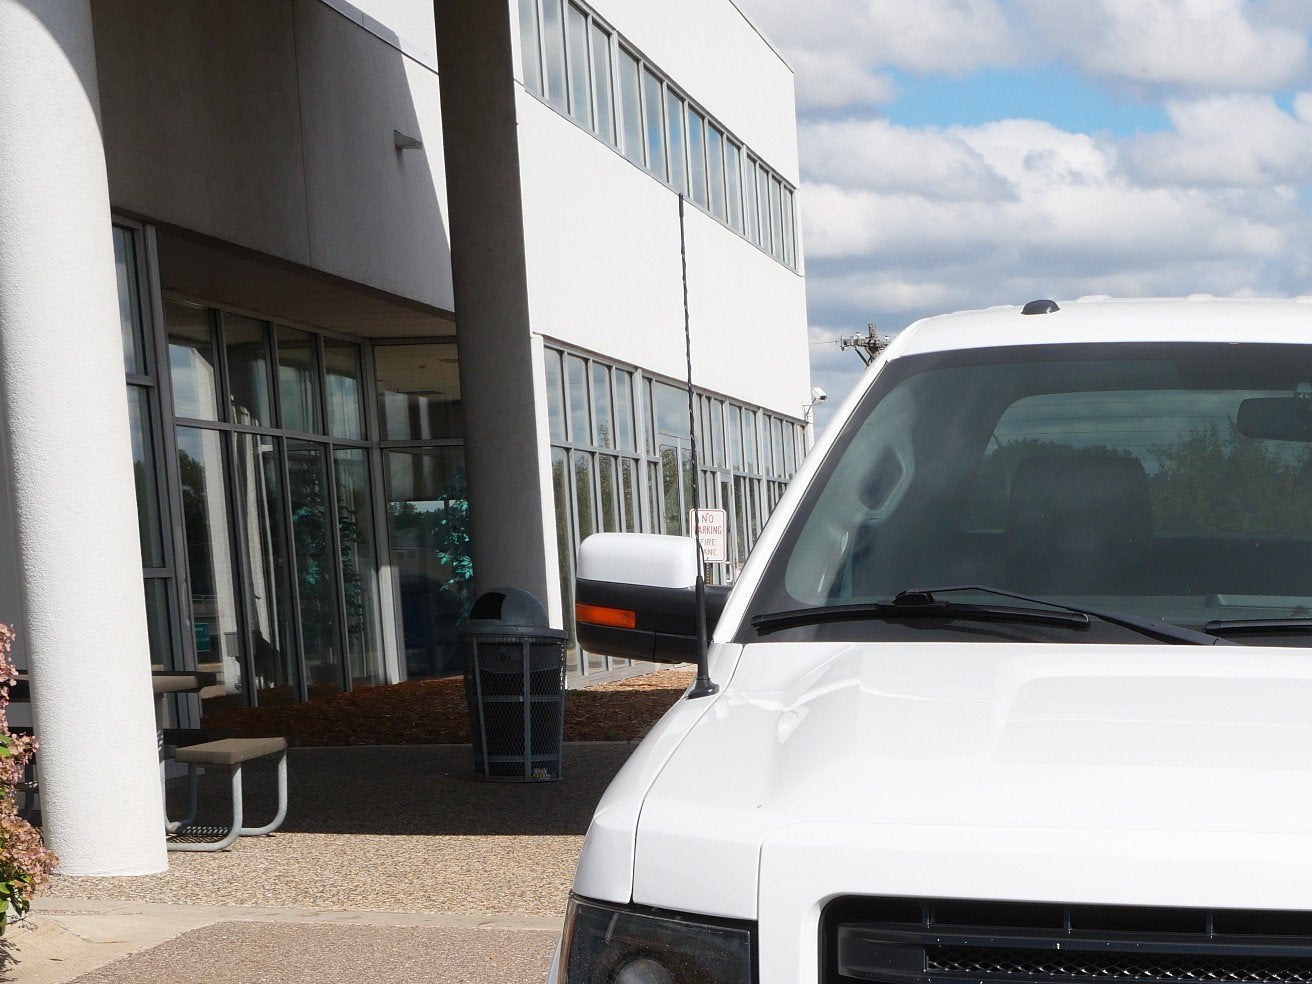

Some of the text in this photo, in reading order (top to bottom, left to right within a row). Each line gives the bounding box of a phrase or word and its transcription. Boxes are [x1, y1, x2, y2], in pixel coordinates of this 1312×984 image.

[702, 514, 714, 524] NO
[695, 525, 722, 535] ARKING
[700, 538, 716, 546] FIRE
[699, 548, 717, 556] ANE
